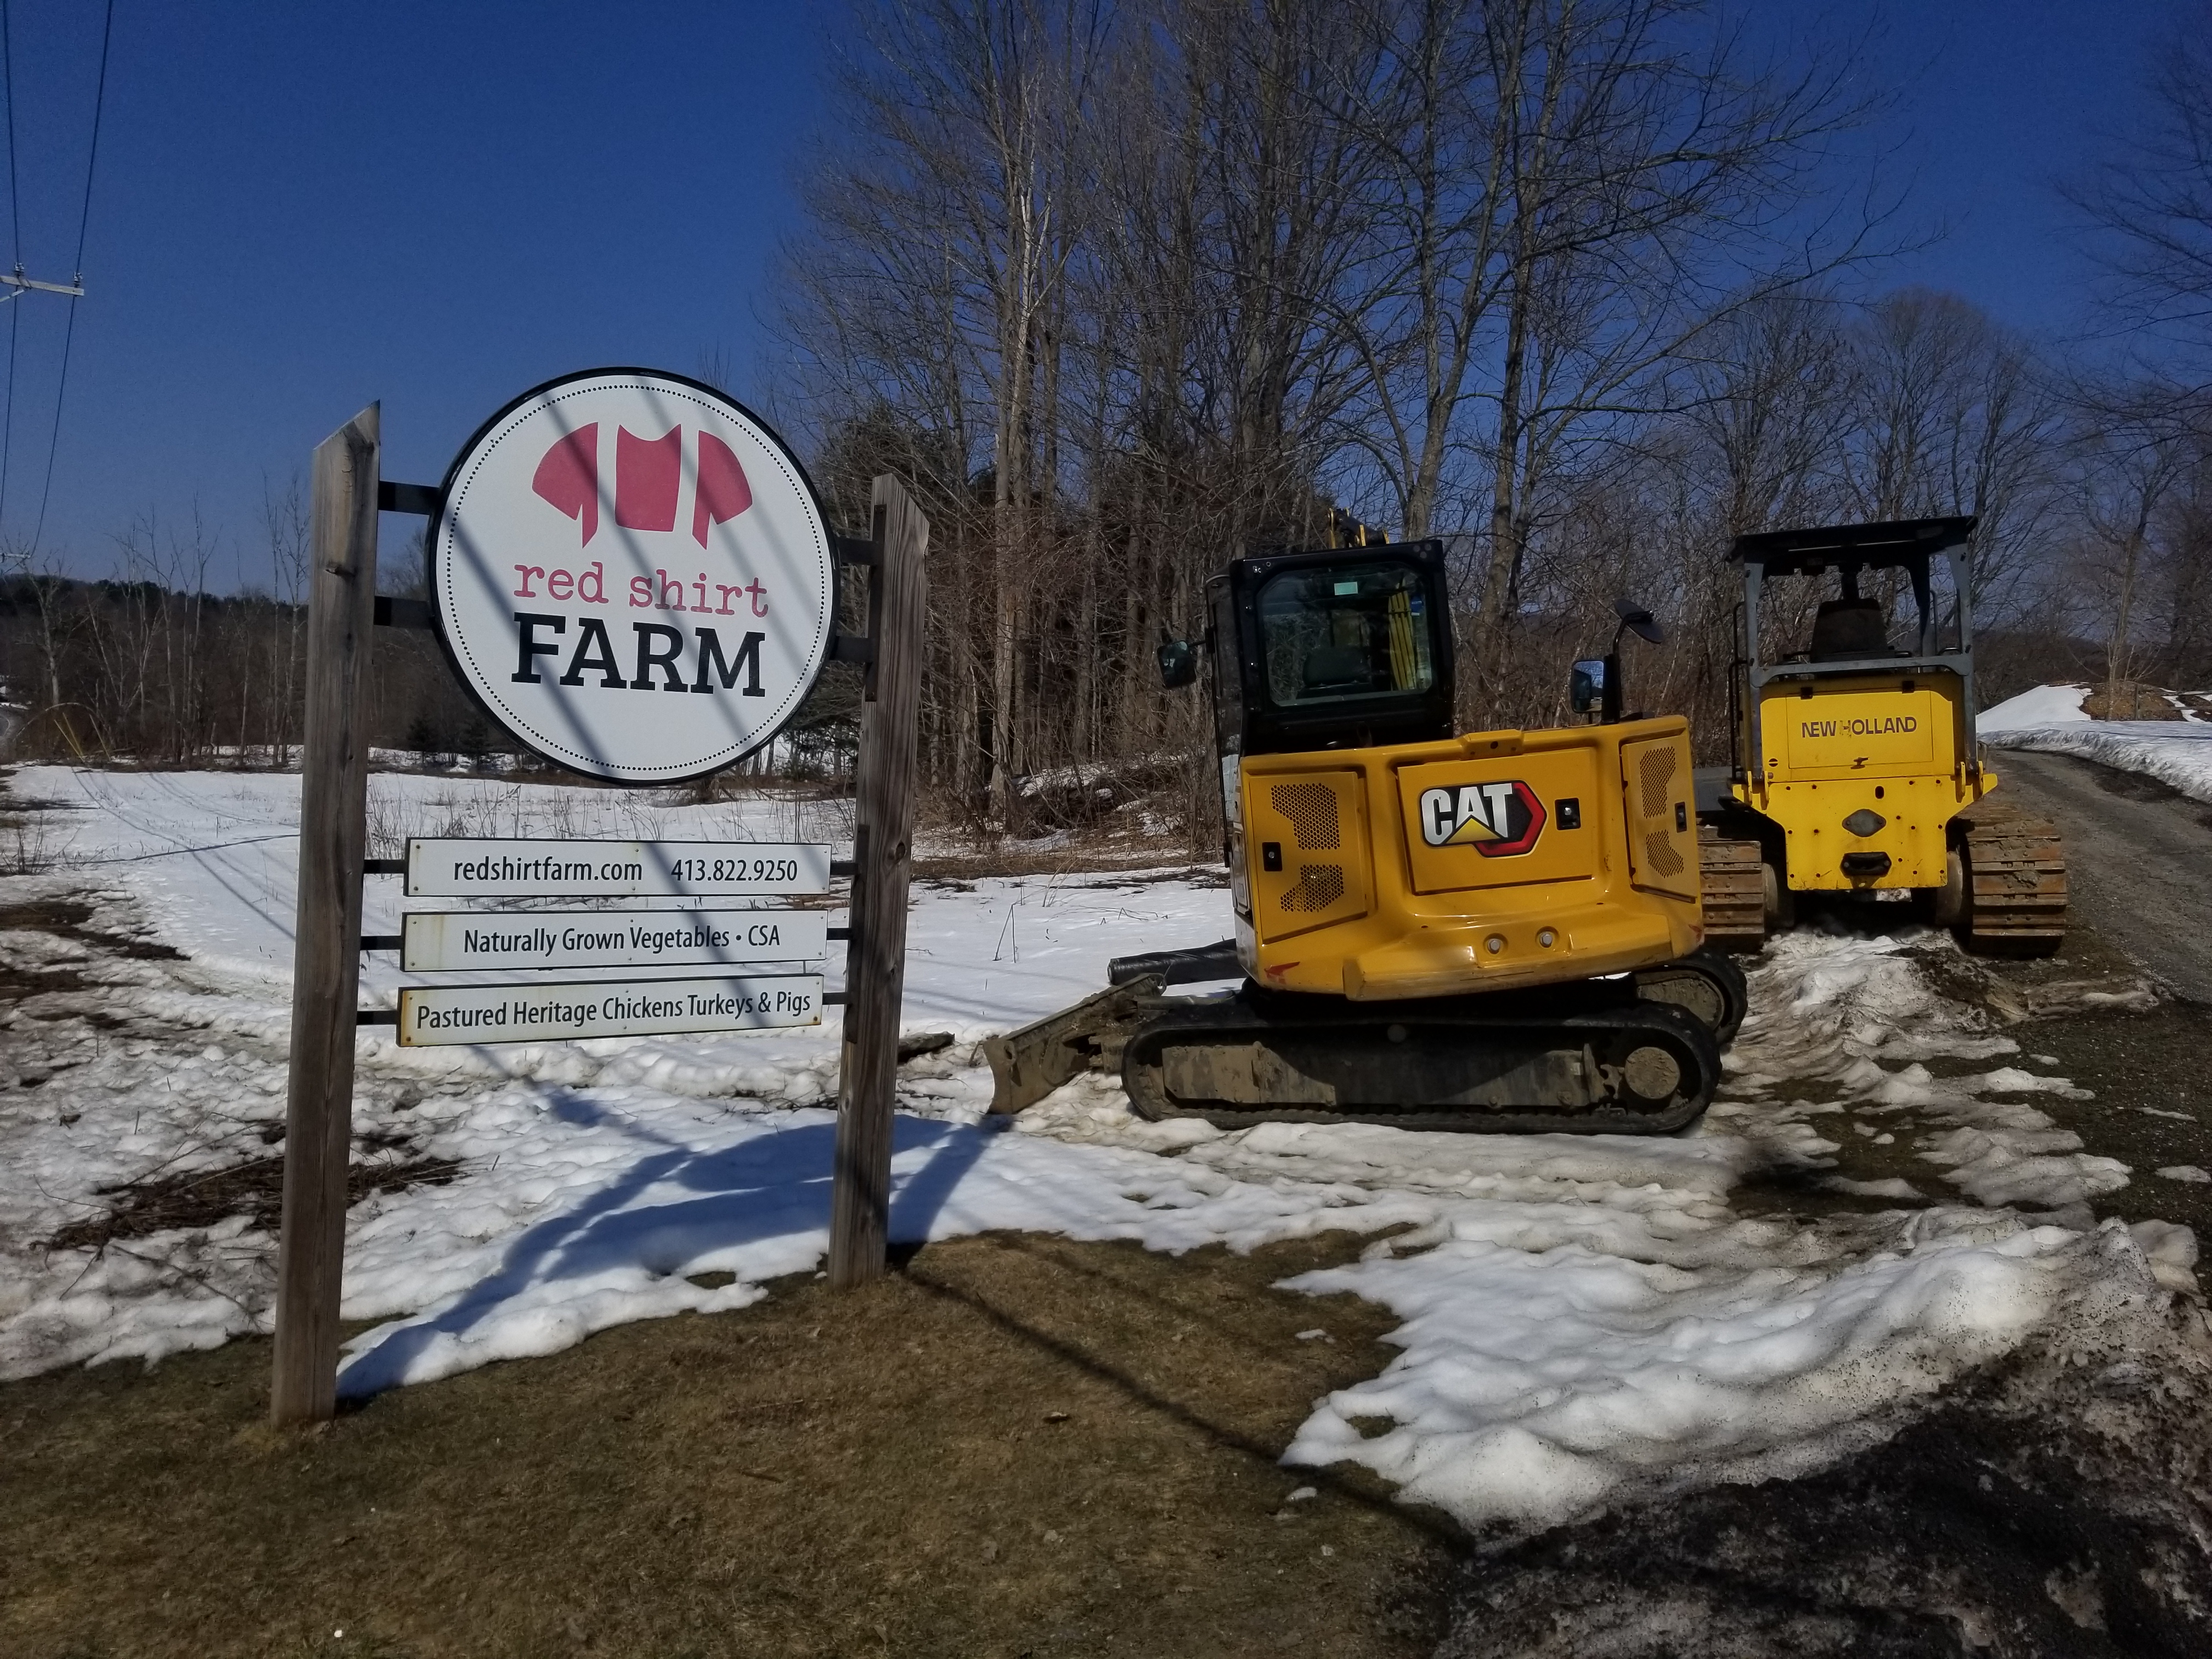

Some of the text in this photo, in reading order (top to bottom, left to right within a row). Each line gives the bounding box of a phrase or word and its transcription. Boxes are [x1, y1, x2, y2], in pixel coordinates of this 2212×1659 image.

[514, 562, 769, 617] red shirt
[511, 612, 765, 697] FARM
[1802, 720, 1837, 738] NEW
[1421, 783, 1513, 844] CAT
[454, 856, 798, 881] redshirtfarm.com 413.822.9250
[464, 925, 780, 957] Naturally Grown Vegetables CSA
[417, 991, 811, 1029] Pastured Heritage Chickens Turkeys & Pigs
